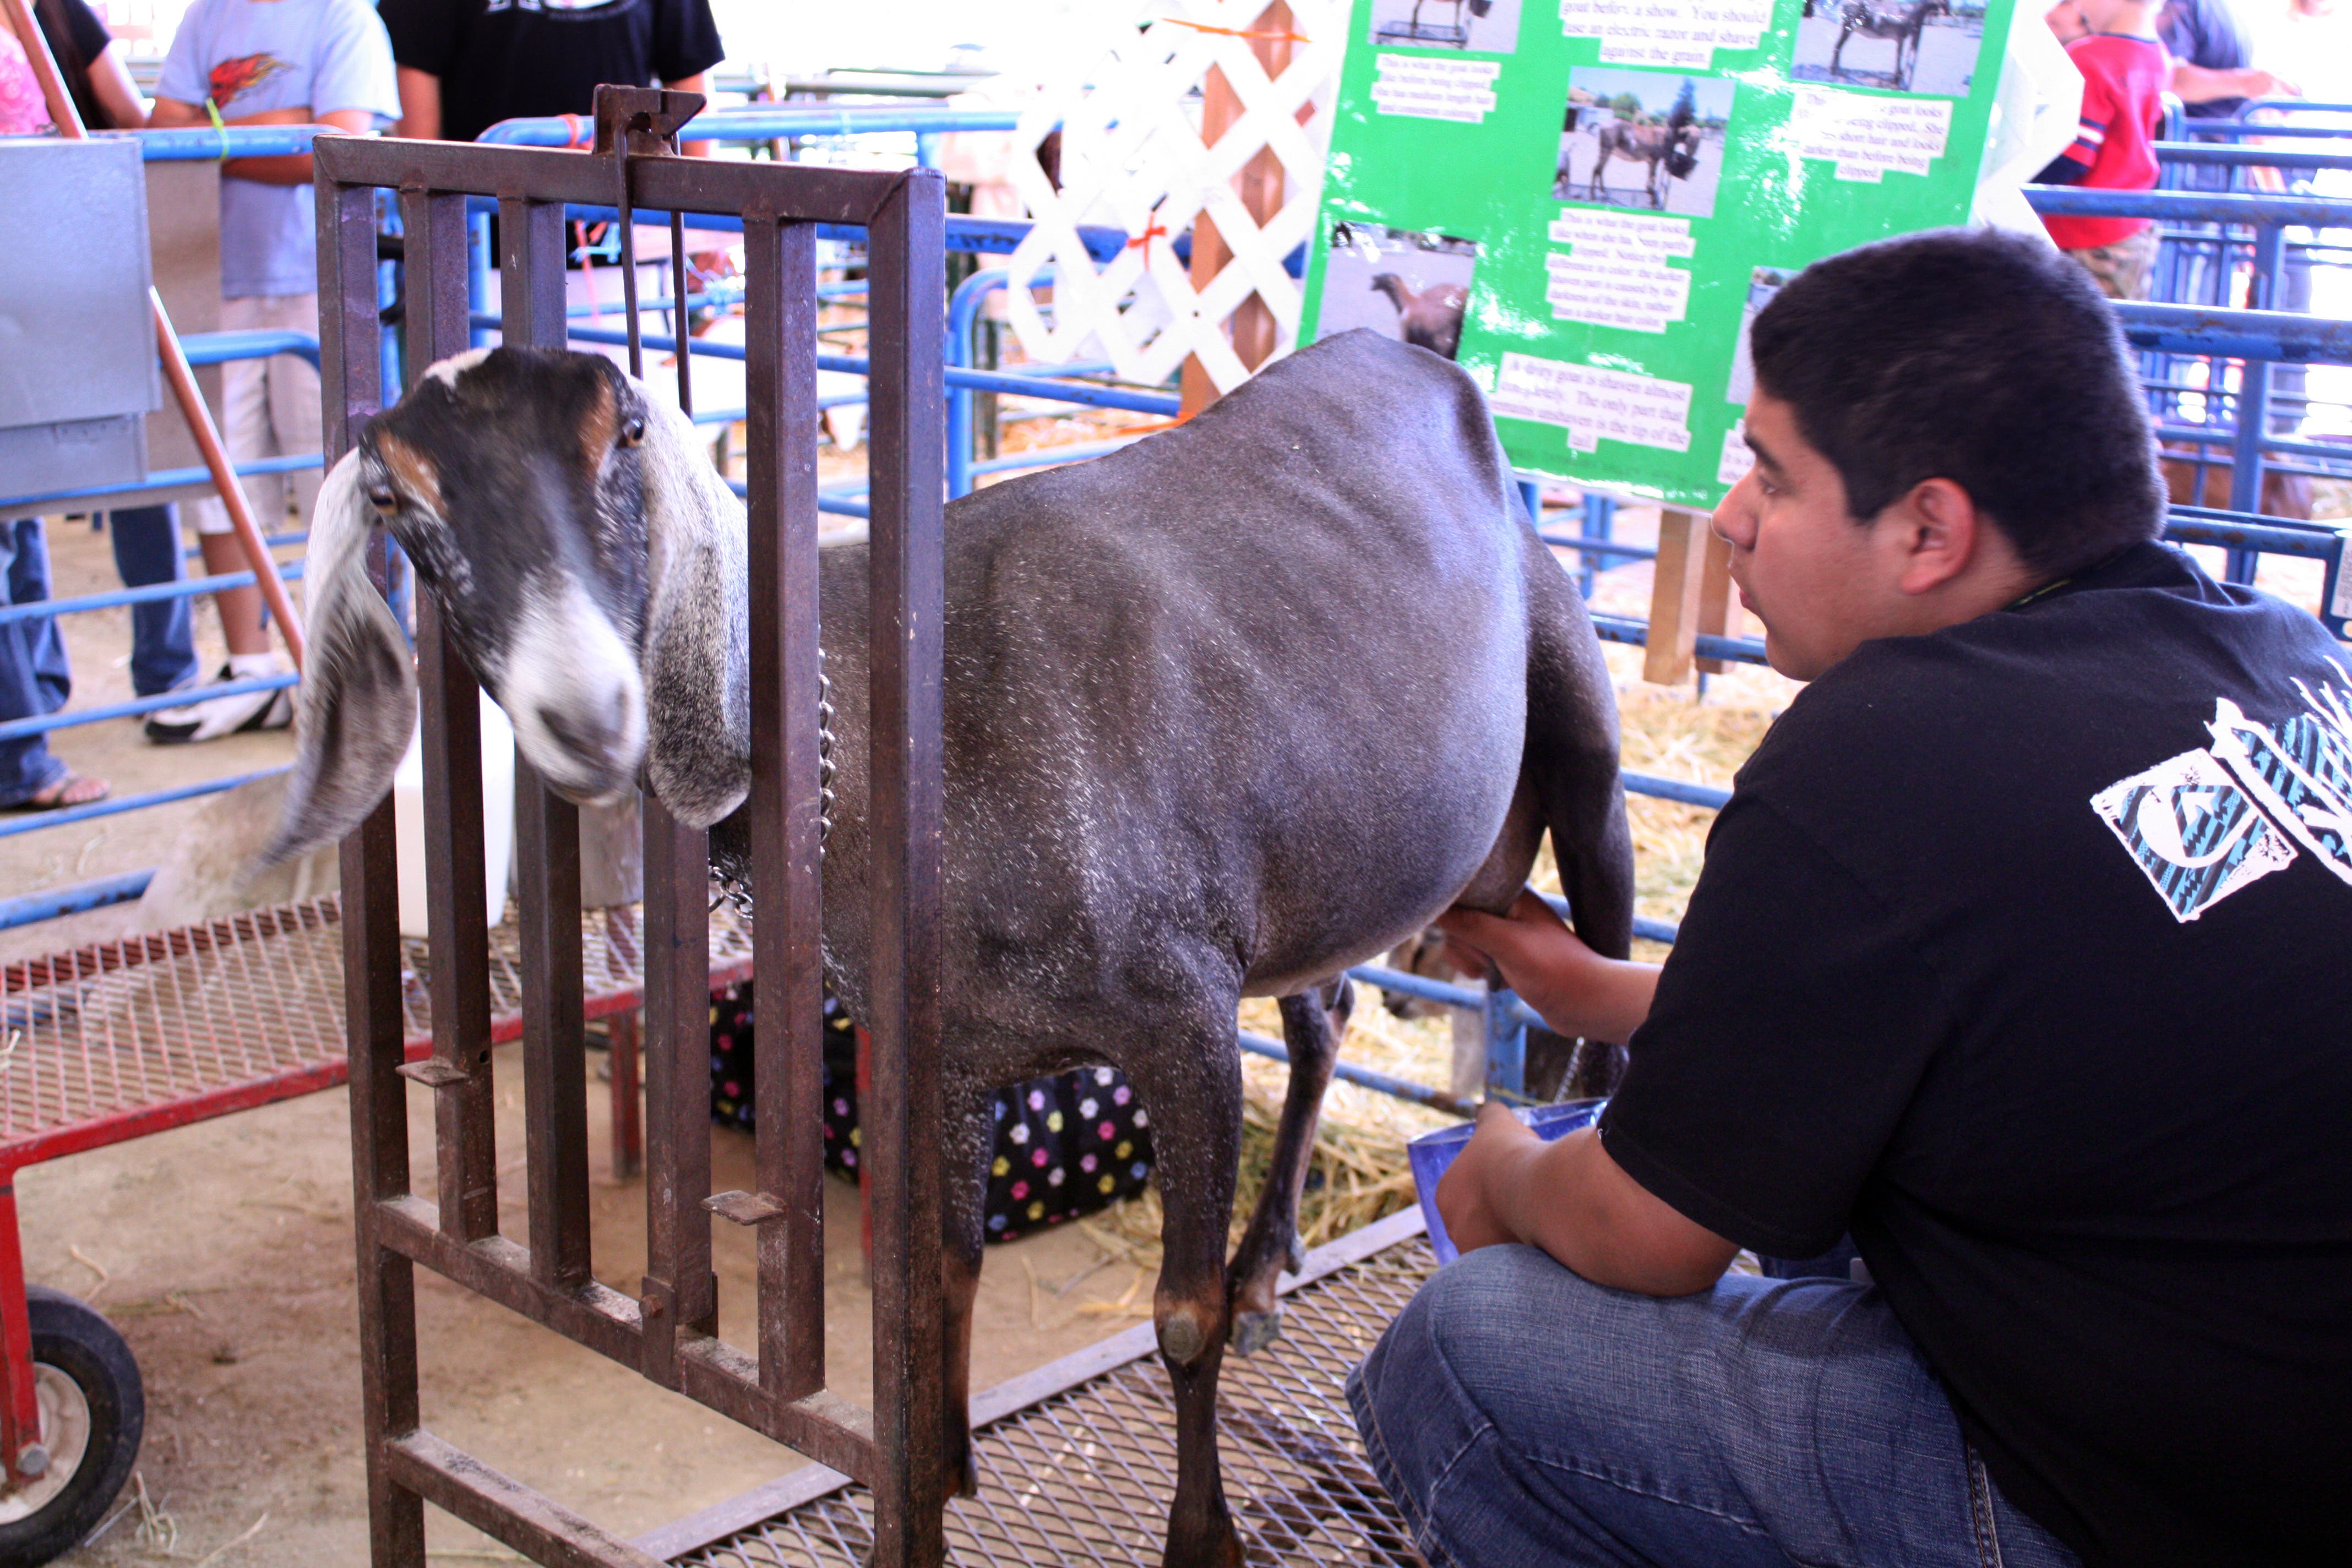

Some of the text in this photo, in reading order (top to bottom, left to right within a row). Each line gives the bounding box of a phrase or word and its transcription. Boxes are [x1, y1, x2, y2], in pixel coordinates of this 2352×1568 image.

[1691, 6, 1718, 20] You
[1722, 9, 1767, 23] should
[1691, 29, 1716, 42] and
[1719, 30, 1758, 44] shave
[1649, 46, 1670, 59] the
[1621, 219, 1634, 228] the
[1663, 287, 1678, 297] the
[1585, 374, 1596, 385] is
[1599, 374, 1641, 393] shaven
[1576, 390, 1599, 407] The
[1601, 397, 1627, 415] only
[1597, 418, 1606, 430] is
[1609, 417, 1628, 433] the
[1668, 426, 1686, 445] the
